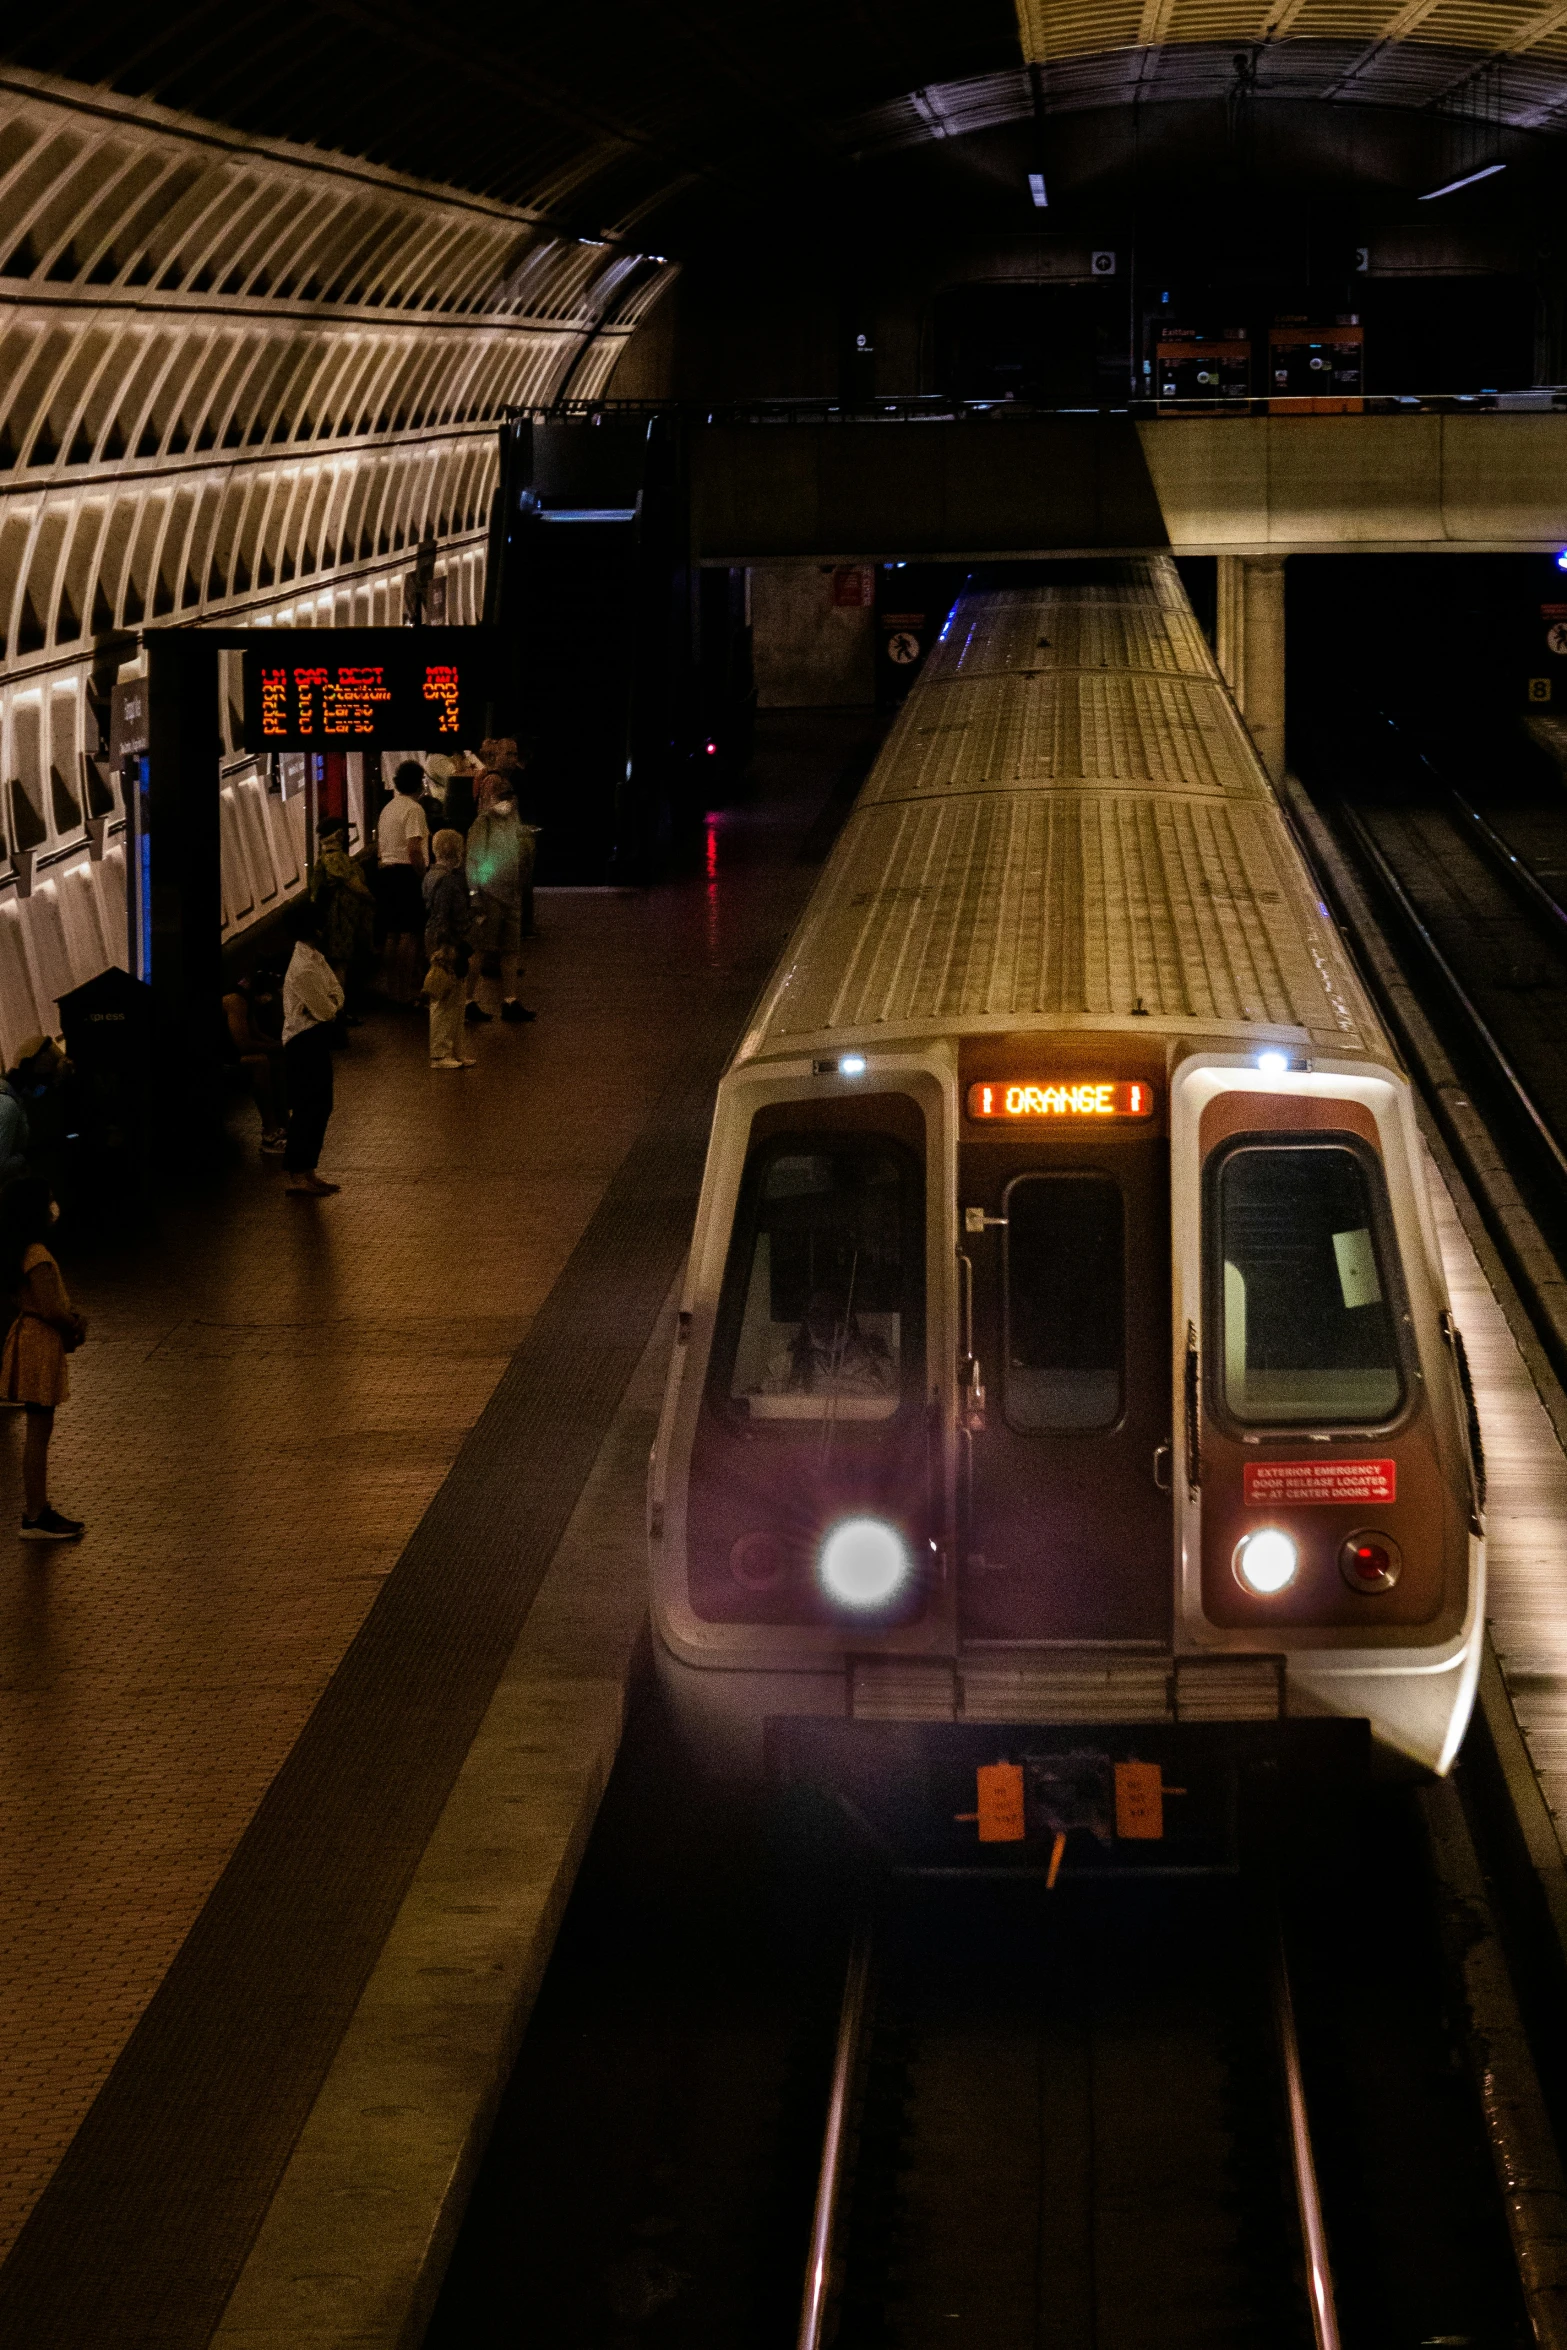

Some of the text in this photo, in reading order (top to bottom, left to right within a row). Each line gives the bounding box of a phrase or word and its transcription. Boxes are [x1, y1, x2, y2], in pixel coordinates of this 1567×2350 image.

[294, 667, 329, 686] CAR
[426, 666, 459, 684] MIN
[322, 683, 392, 701] Stadium
[1533, 681, 1546, 698] 8
[438, 714, 460, 732] 14
[1005, 1085, 1115, 1114] ORANGE
[1257, 1465, 1380, 1479] EXTERIOR EMERGENCY
[1252, 1475, 1387, 1489] DOOR RELEASE LOCATED
[1269, 1487, 1370, 1499] AT CENTER DOORS
